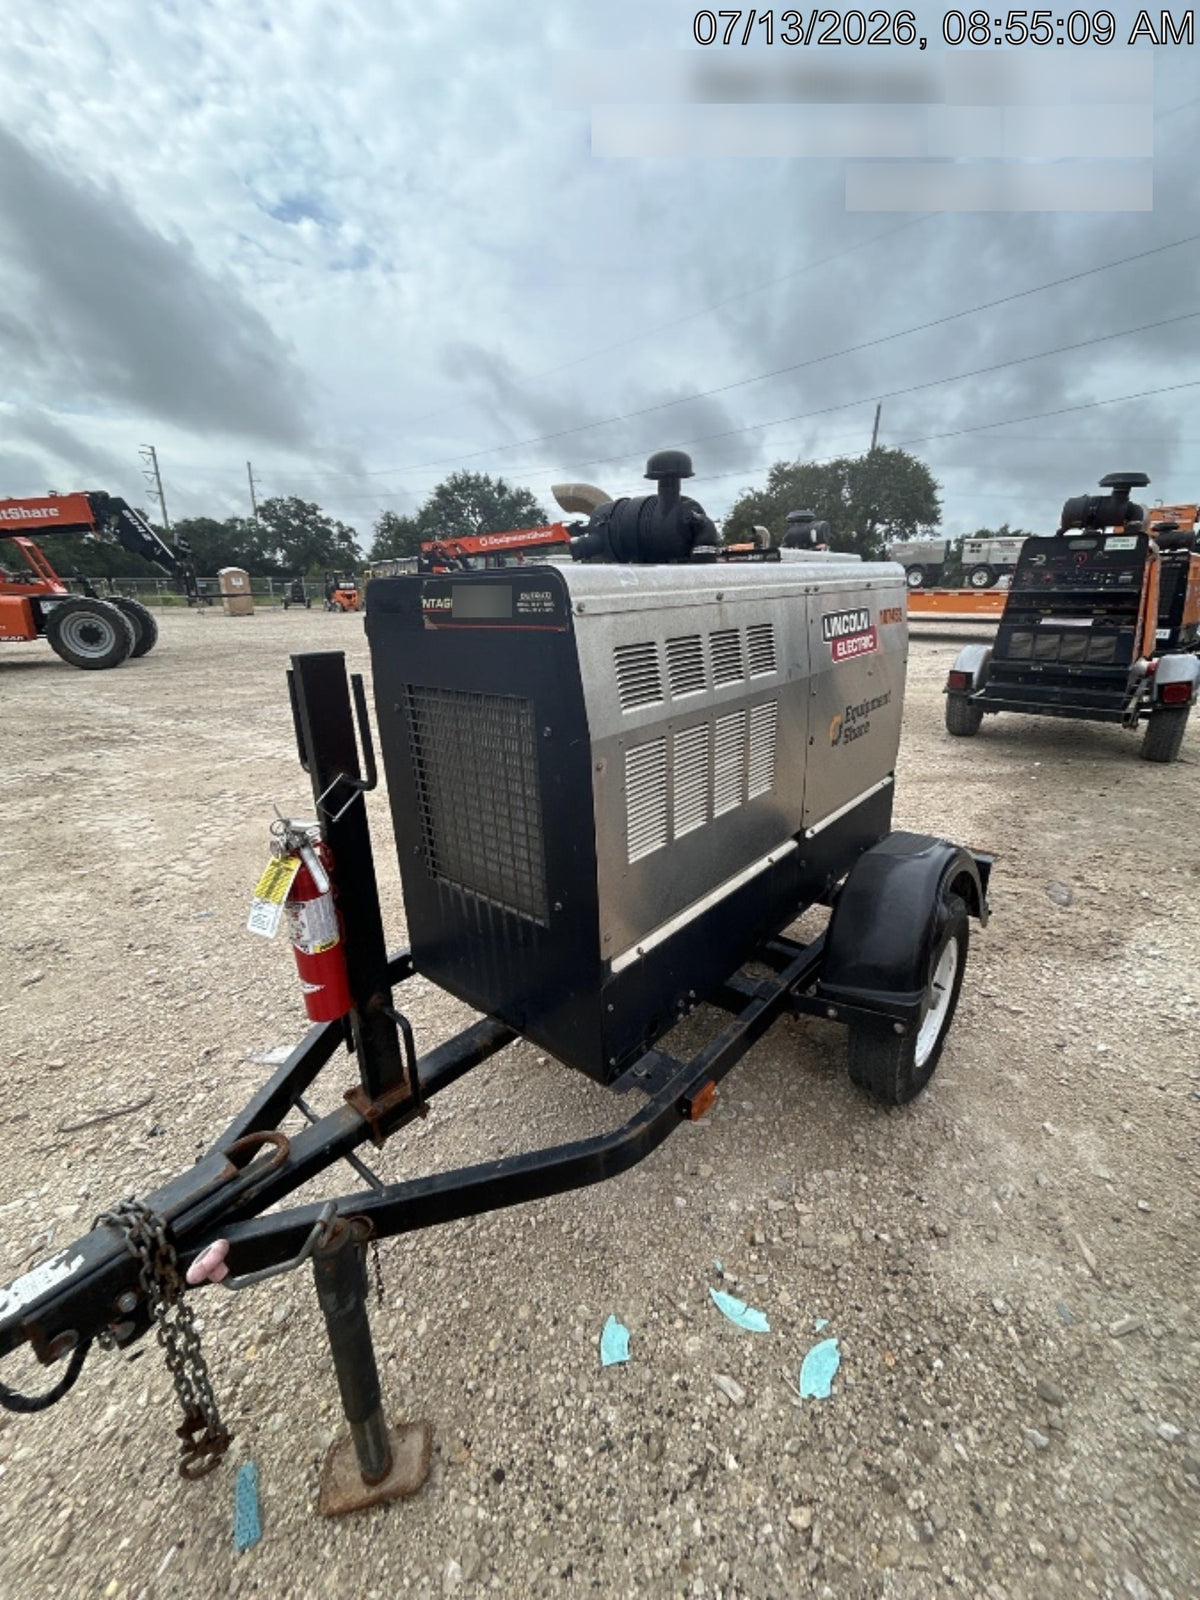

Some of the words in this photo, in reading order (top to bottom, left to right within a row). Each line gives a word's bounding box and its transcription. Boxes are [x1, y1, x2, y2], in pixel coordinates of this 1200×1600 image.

[0, 506, 59, 520] tShare
[422, 598, 453, 609] NTAG
[824, 611, 869, 638] LINCOLN
[837, 635, 874, 657] ELECTRIC
[845, 689, 891, 724] Equipment
[843, 721, 870, 745] Share
